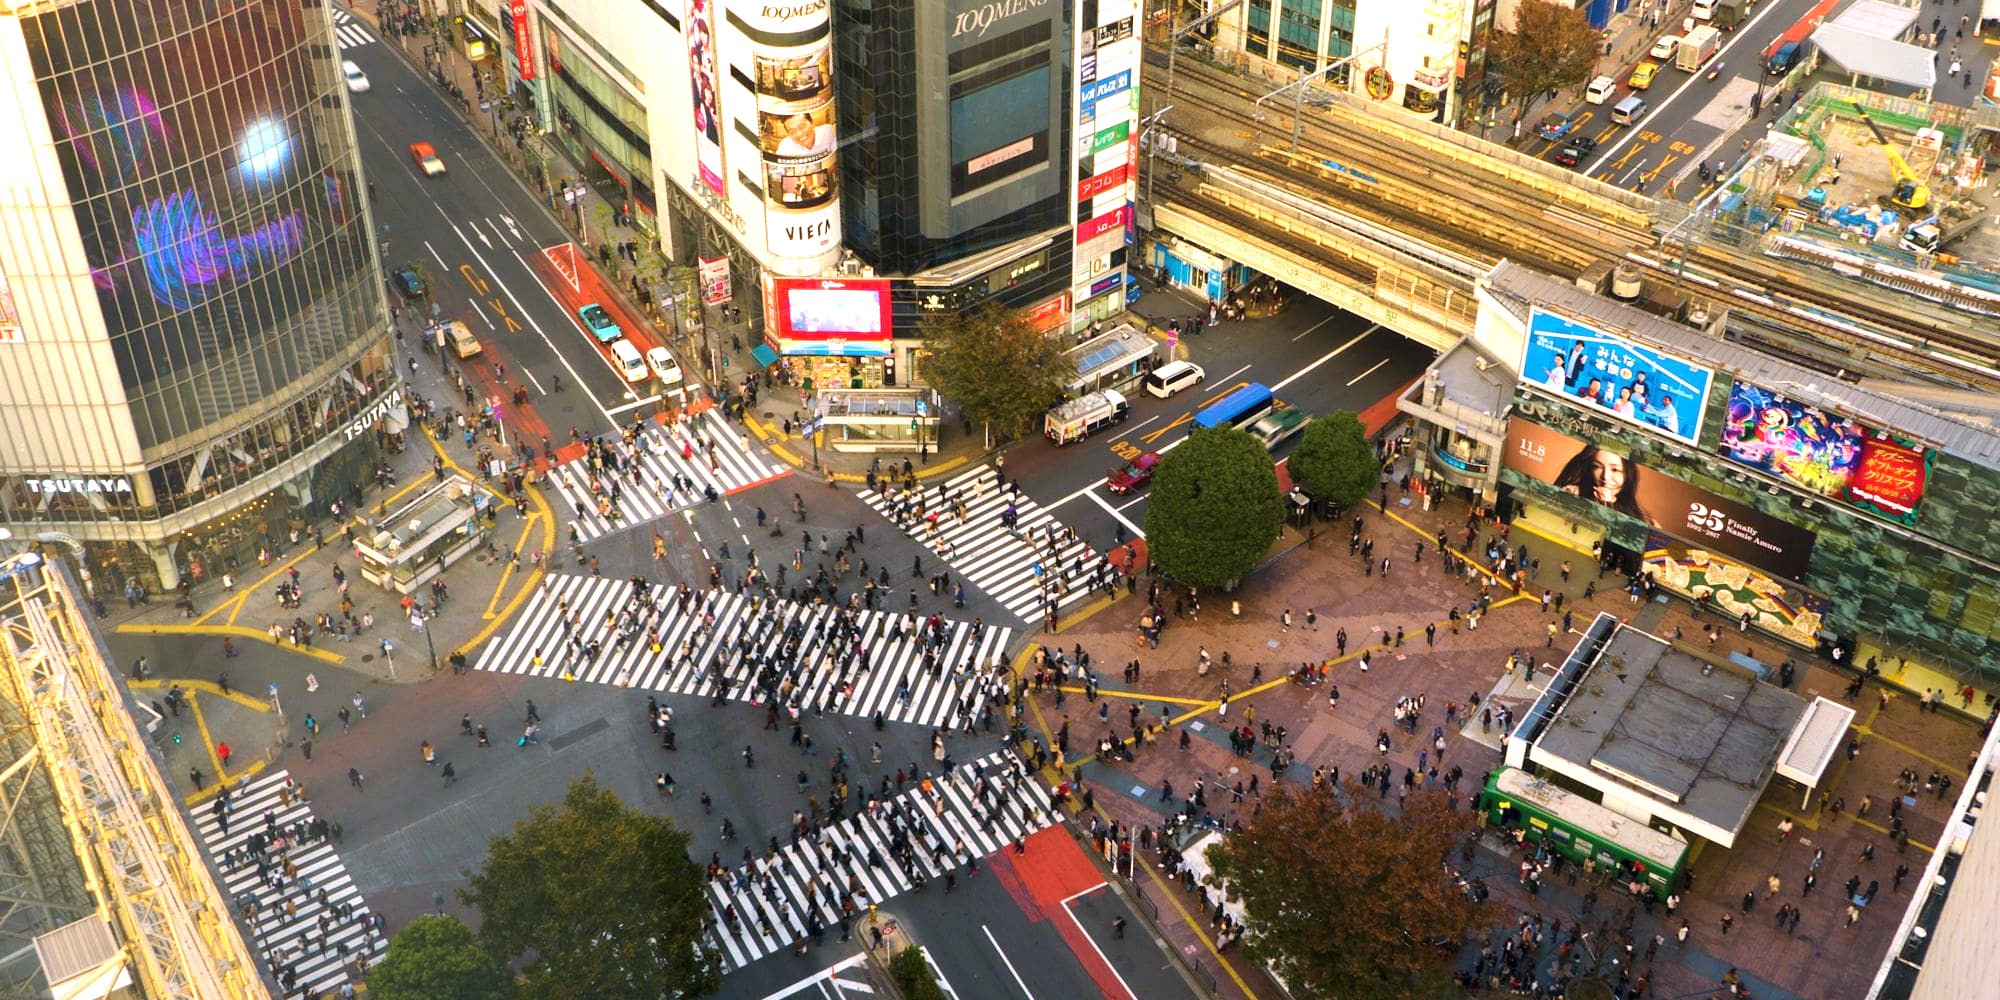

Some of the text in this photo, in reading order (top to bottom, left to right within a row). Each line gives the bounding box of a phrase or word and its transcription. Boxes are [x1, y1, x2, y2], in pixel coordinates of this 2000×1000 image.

[1082, 176, 1113, 196] アコム
[1597, 346, 1635, 367] みんな
[344, 390, 401, 441] TSUTAYA
[1110, 441, 1143, 460] 8-20
[1520, 438, 1546, 456] 11.8
[27, 479, 131, 493] TSUTAYA
[1864, 469, 1915, 493] クリスマス
[1687, 502, 1725, 531] 25
[1727, 518, 1758, 536] Finally
[1726, 526, 1782, 553] Namie Amuro
